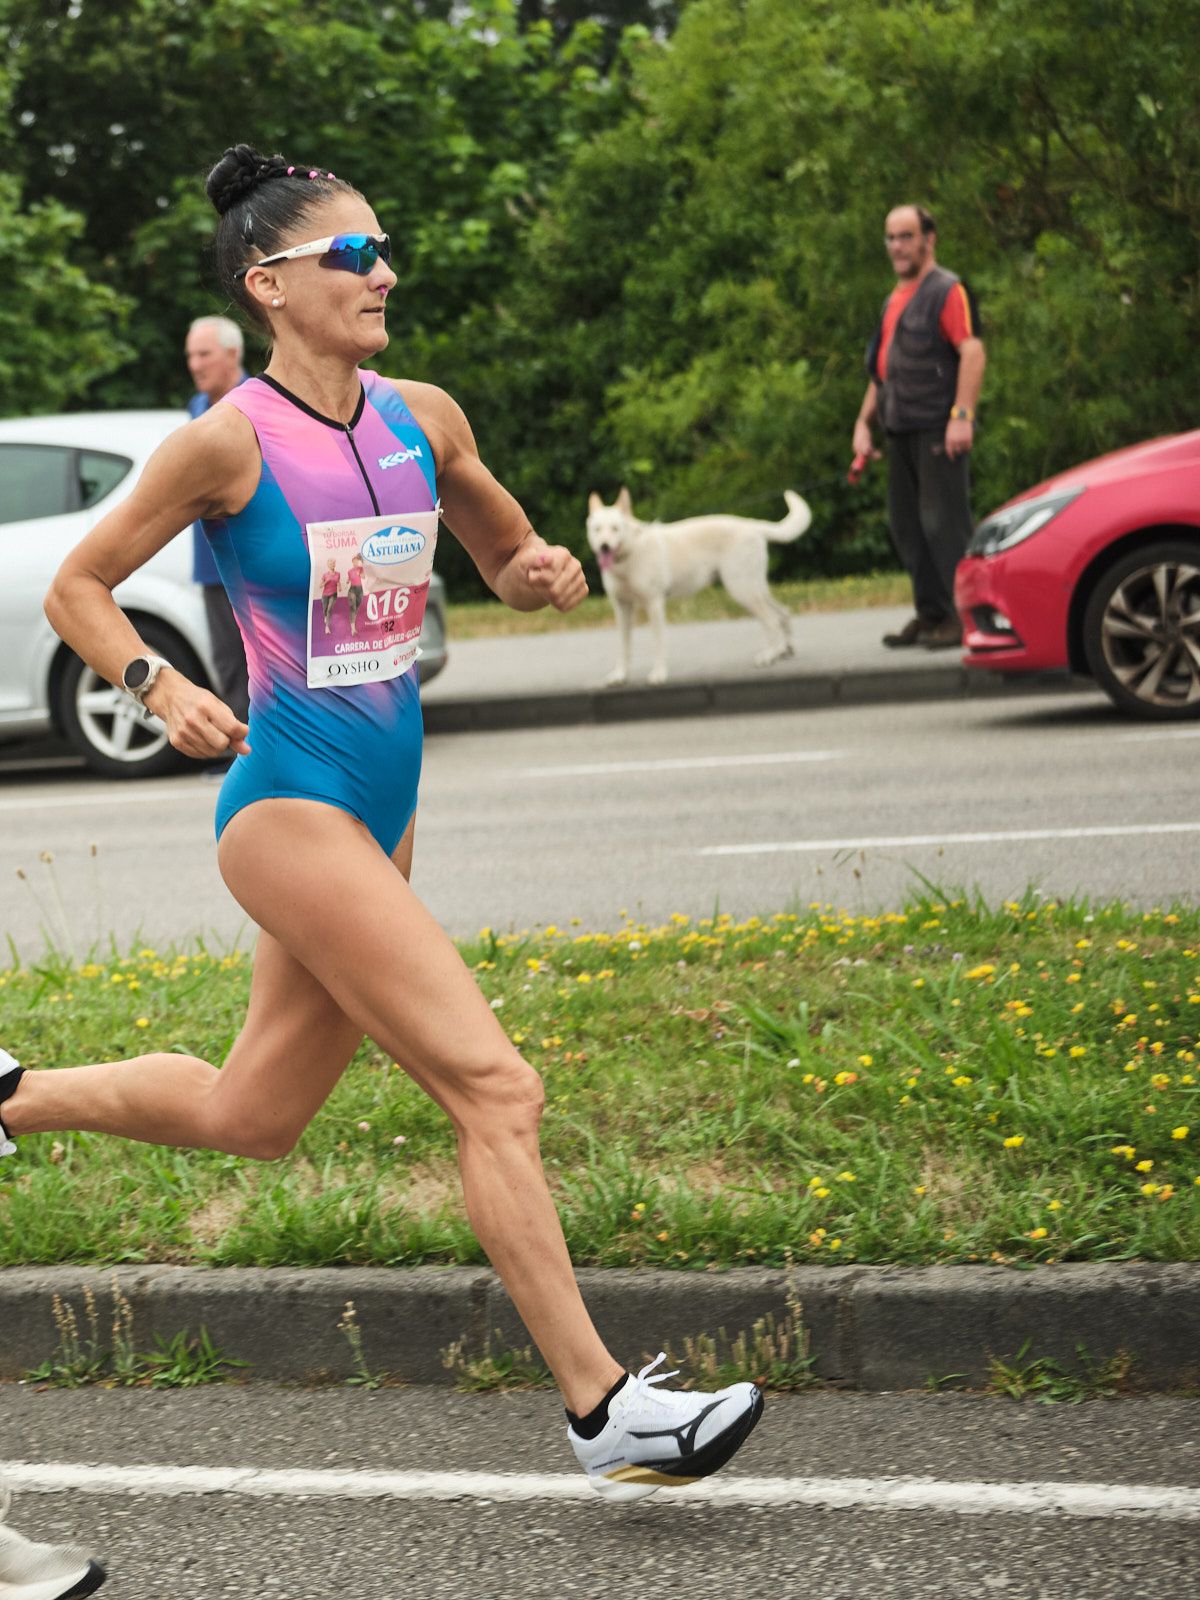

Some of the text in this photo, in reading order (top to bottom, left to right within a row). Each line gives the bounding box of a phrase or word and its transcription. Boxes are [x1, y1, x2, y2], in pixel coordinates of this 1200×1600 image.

[326, 537, 358, 549] SUMA
[367, 542, 421, 557] ASTURIANA
[335, 641, 371, 654] CARRERA
[373, 639, 383, 649] DE
[328, 659, 380, 676] OYSHO
